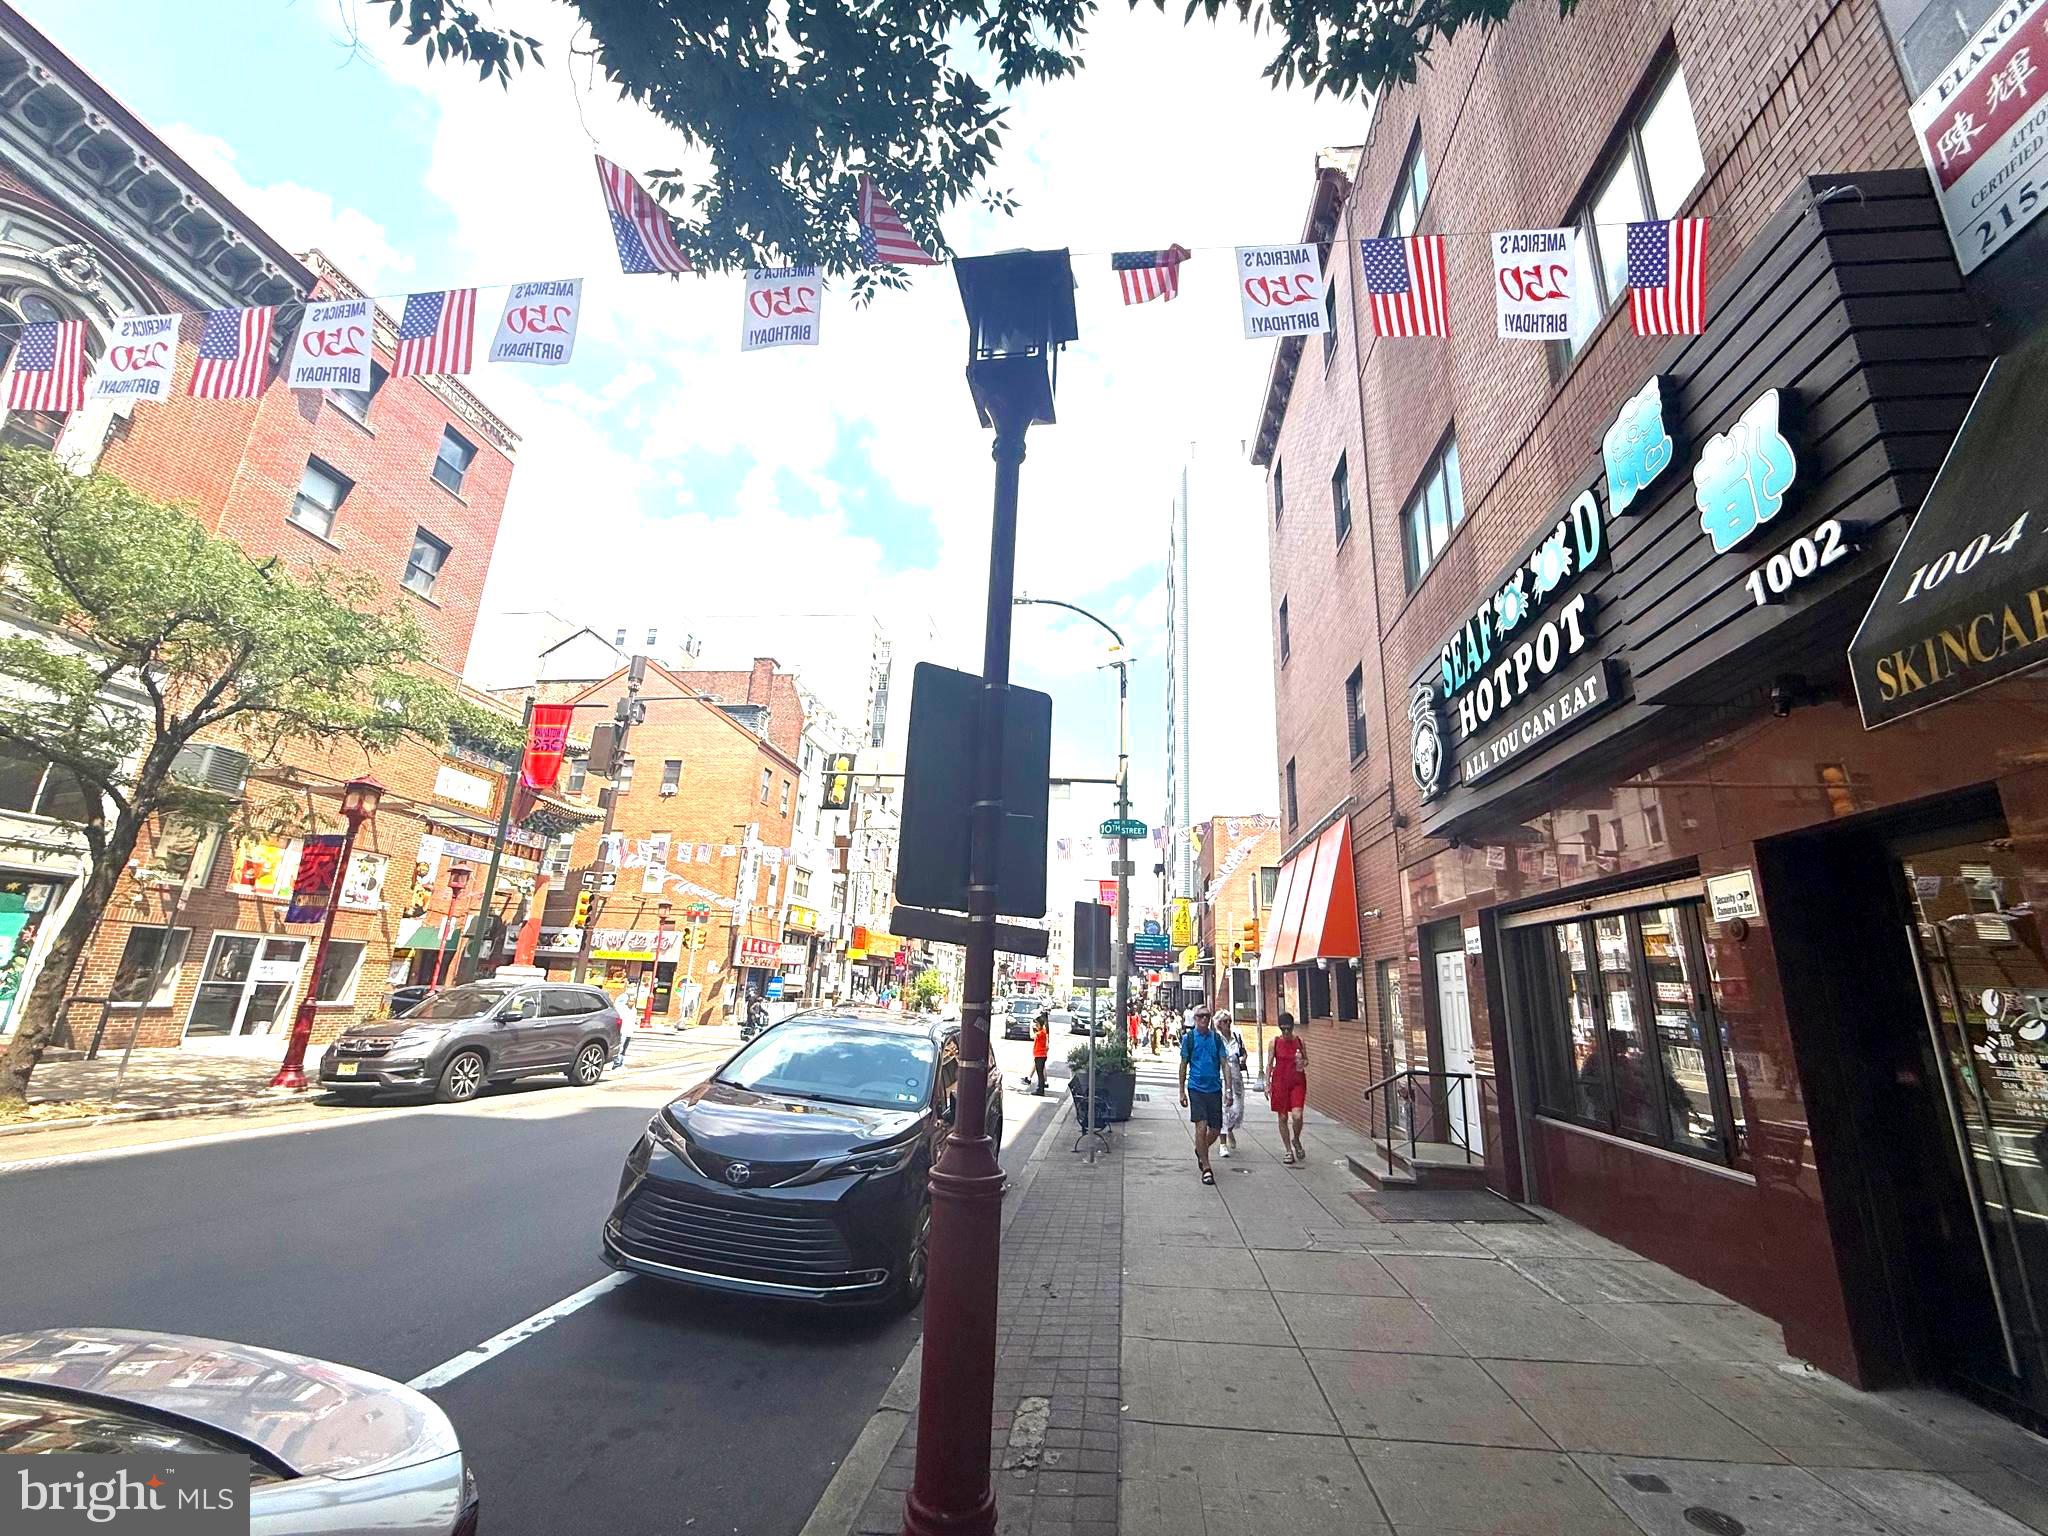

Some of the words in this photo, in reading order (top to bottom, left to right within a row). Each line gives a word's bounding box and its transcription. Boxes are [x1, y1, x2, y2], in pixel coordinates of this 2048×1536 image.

[1936, 20, 2048, 170] 陳輝
[2009, 105, 2048, 153] ATTO
[1971, 135, 2044, 209] CERTIFIED
[1745, 519, 1849, 607] 1002
[1898, 510, 2030, 605] 1004
[1458, 593, 1586, 739] HOTPOT
[1464, 752, 1489, 782] ALL
[1491, 731, 1519, 770] YOU
[1521, 705, 1557, 745] CAN
[1560, 675, 1599, 720] EAT
[1715, 894, 1735, 905] Security
[1717, 906, 1737, 915] Cameras
[1998, 1052, 2037, 1064] SEAFOOD
